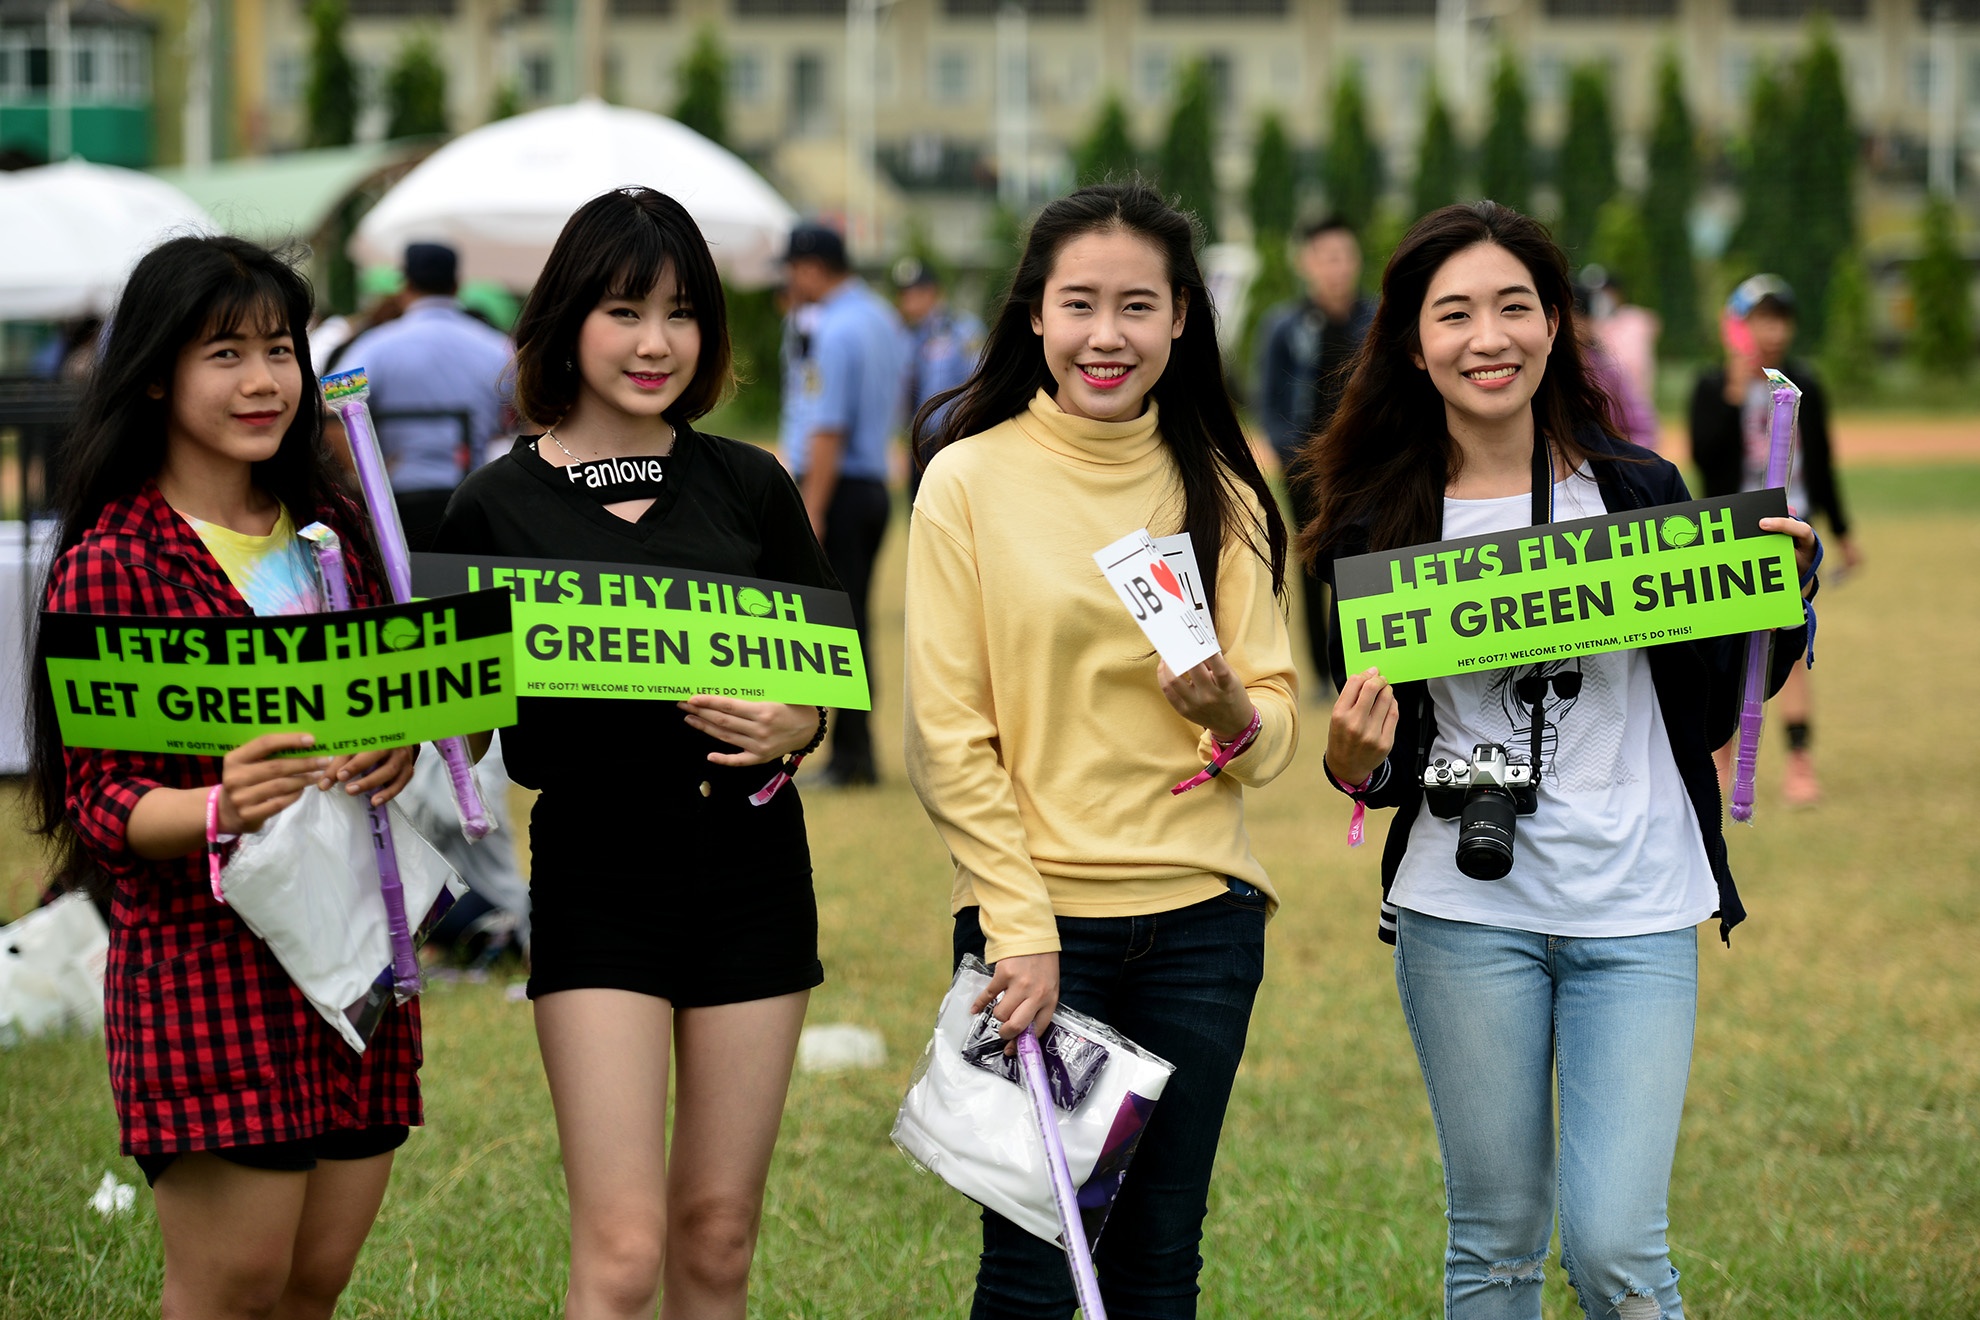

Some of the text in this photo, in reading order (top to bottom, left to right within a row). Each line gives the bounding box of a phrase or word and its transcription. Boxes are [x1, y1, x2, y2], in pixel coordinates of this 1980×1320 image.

[566, 458, 663, 488] Fanlove
[1389, 543, 1504, 593] LET'S
[1518, 529, 1594, 575] FLY
[599, 573, 673, 608] FLY
[1124, 577, 1163, 621] JB
[1356, 556, 1785, 653] LET GREEN SHINE
[95, 626, 210, 665] LET'S
[226, 626, 307, 665] FLY
[525, 624, 853, 677] GREEN SHINE
[1457, 626, 1693, 668] HEY GOT7! WELCOME TO VIETNAM, LET'S DO THIS!
[65, 657, 501, 724] LET GREEN SHINE
[527, 682, 765, 697] HEY GOT7! WELCOME TO VIETNAM, LET'S DO THIS!
[166, 740, 184, 749] HEY
[333, 739, 358, 750] LET'S
[361, 737, 377, 746] DO
